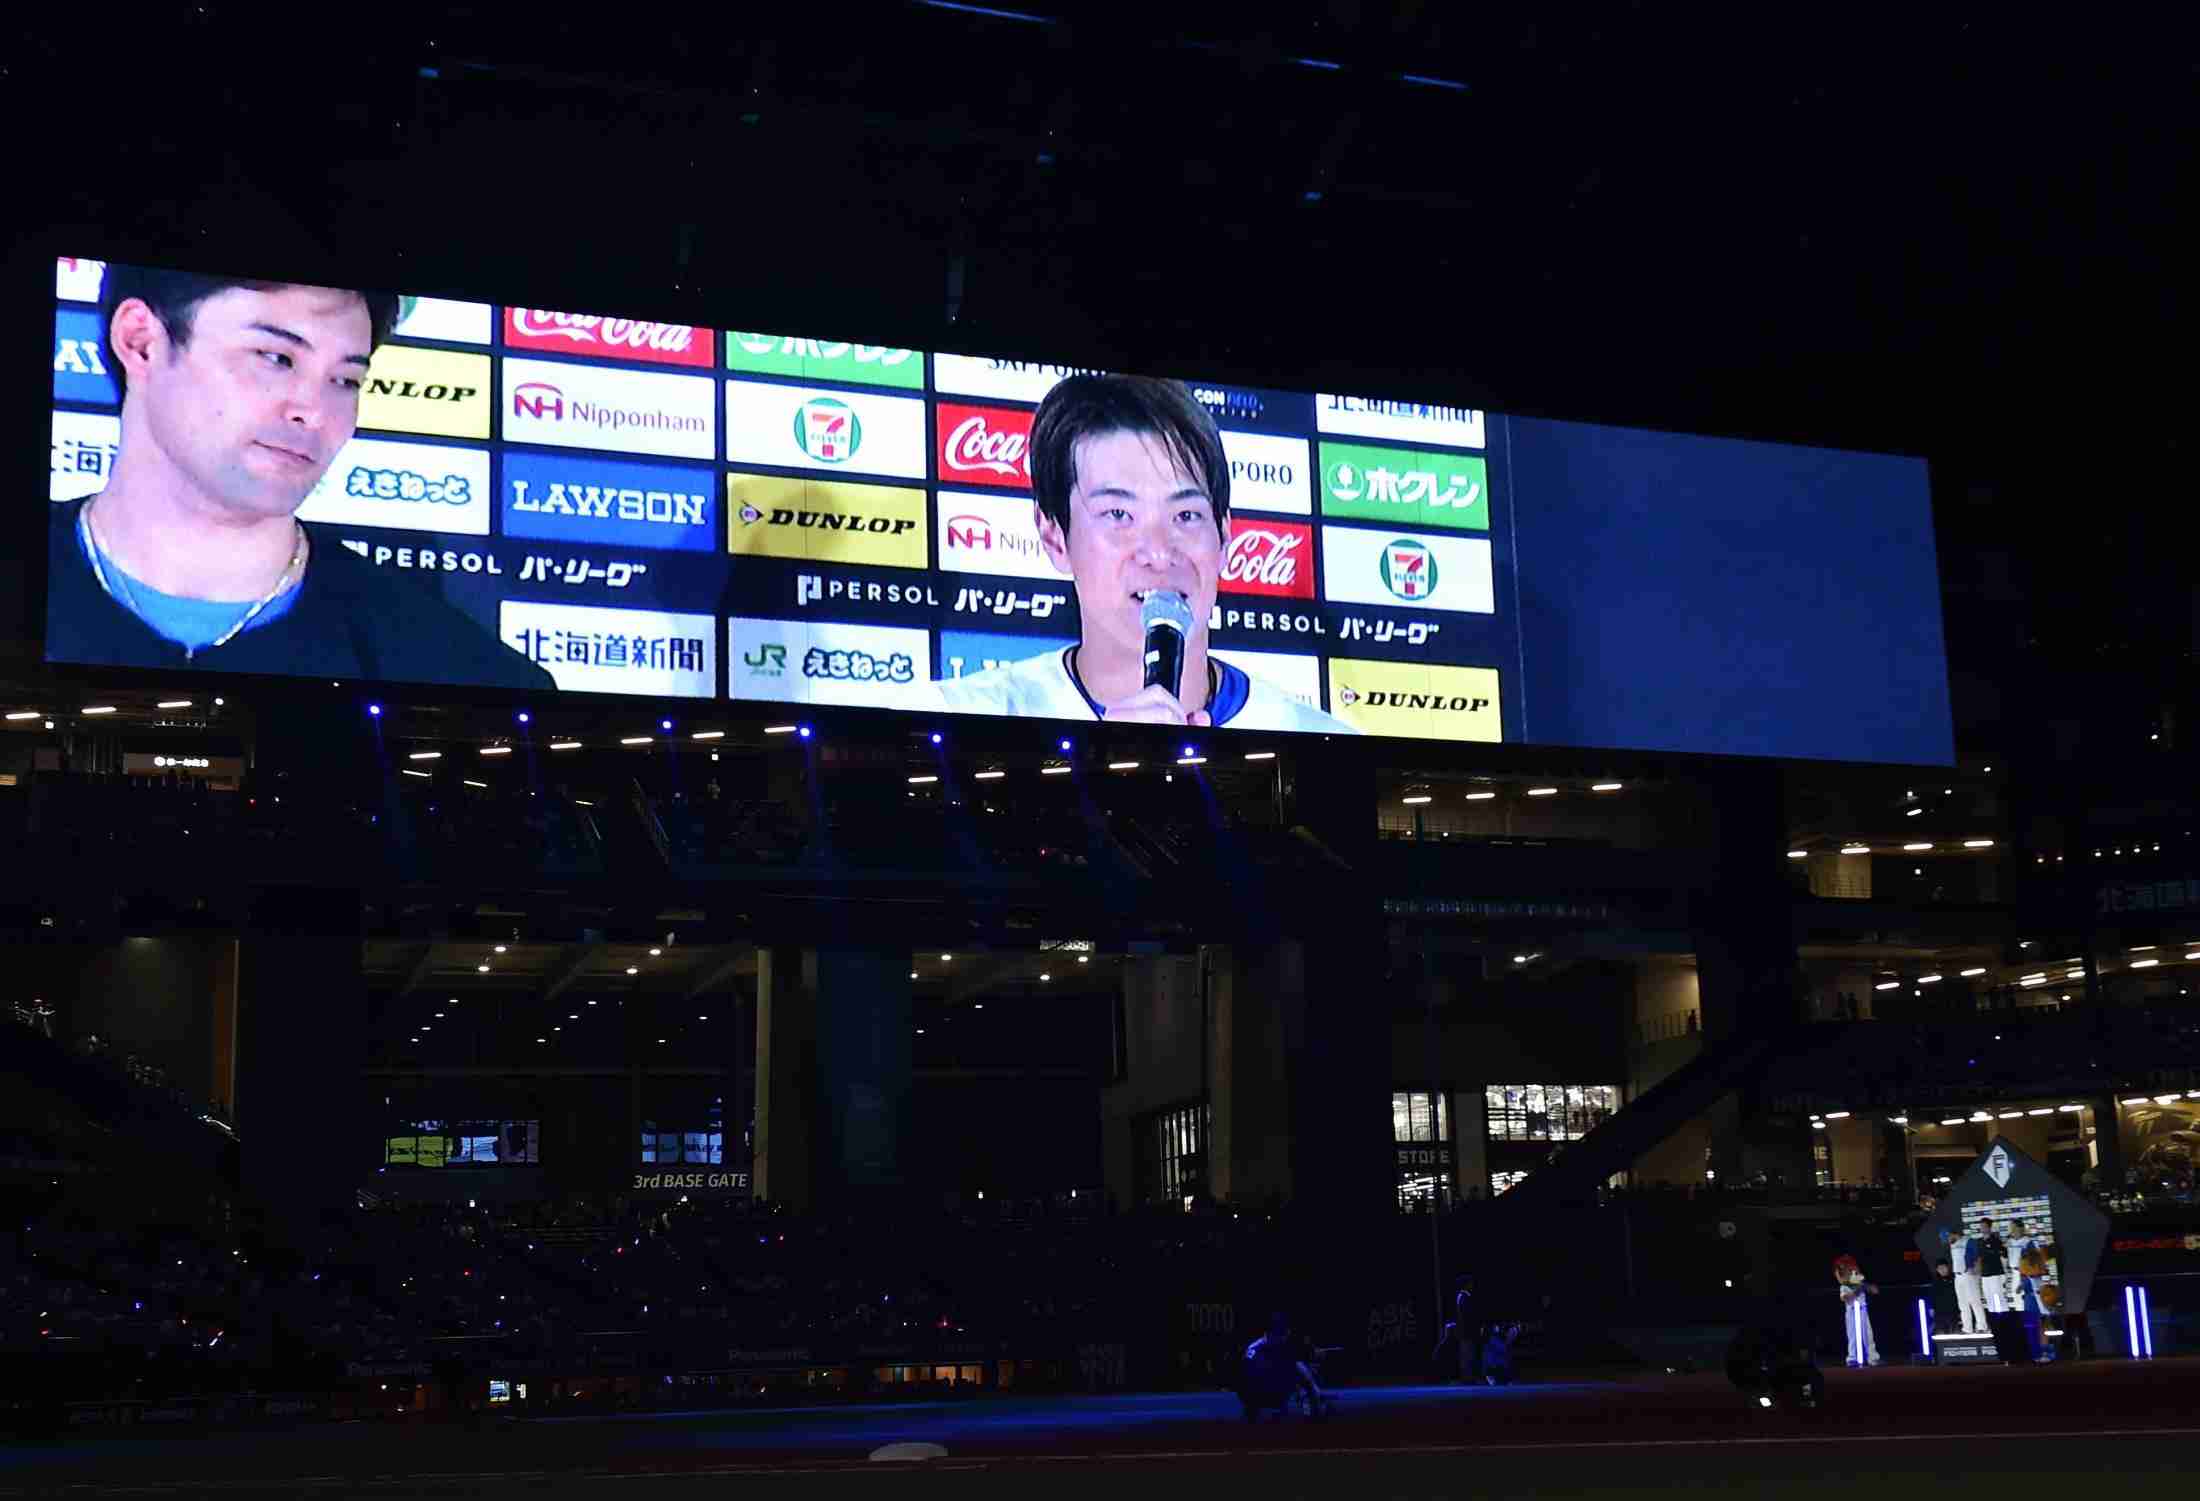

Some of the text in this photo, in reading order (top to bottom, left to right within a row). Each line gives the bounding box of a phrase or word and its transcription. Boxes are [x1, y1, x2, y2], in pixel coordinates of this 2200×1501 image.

[514, 393, 706, 432] NH Nipponham
[345, 465, 472, 506] えきねっと
[512, 480, 706, 525] LAWSON
[1365, 466, 1481, 509] ホクレン
[768, 508, 916, 535] DUNLOP
[375, 546, 647, 587] PERSOL パ・リーグ
[829, 580, 1066, 617] PERSOL パ・リーグ
[1227, 610, 1440, 644] PERSOL パ・リーグ
[515, 628, 704, 673] 北海道新聞
[744, 643, 788, 668] JR
[802, 647, 914, 683] えきねっと
[1365, 691, 1489, 712] DUNLOP
[633, 1173, 748, 1188] 3rd BASE GATE
